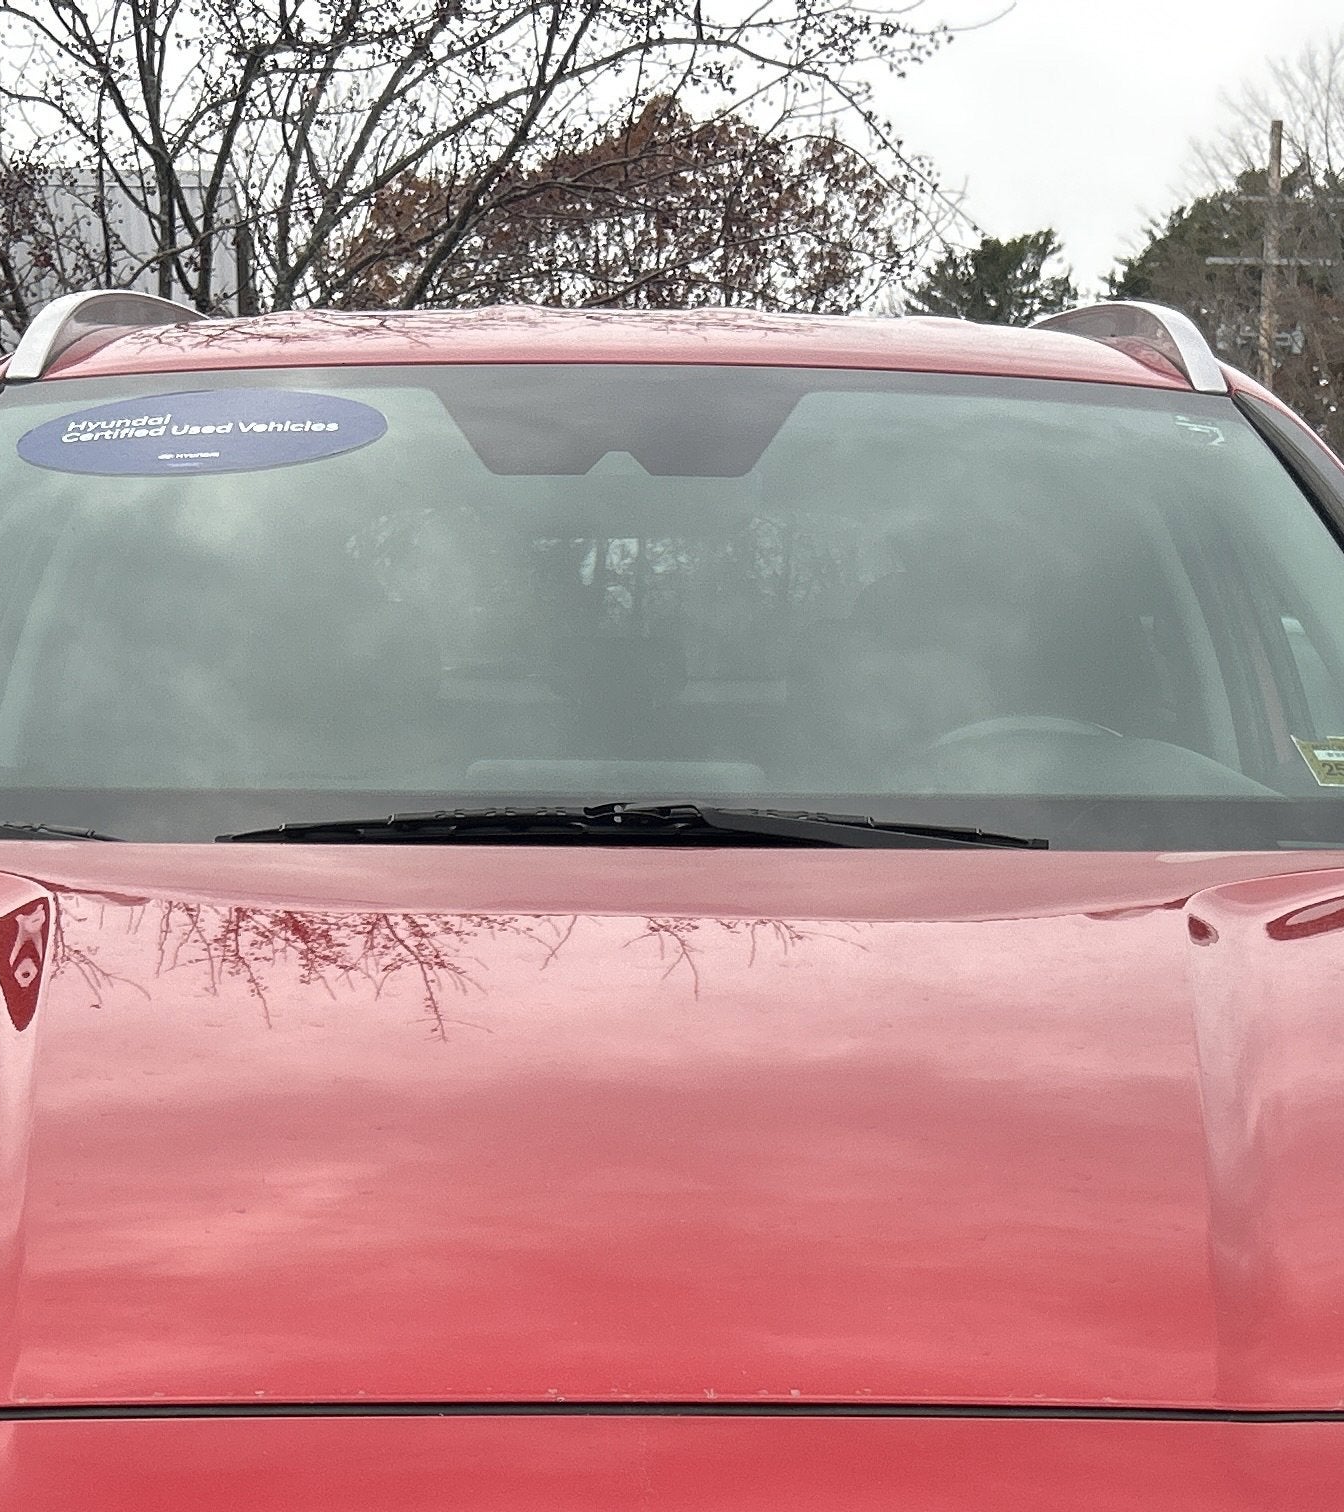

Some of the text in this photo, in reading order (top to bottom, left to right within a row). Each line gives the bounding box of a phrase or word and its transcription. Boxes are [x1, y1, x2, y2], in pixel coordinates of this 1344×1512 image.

[61, 421, 339, 443] Certified Used Vehicles
[67, 414, 172, 432] Hyundai
